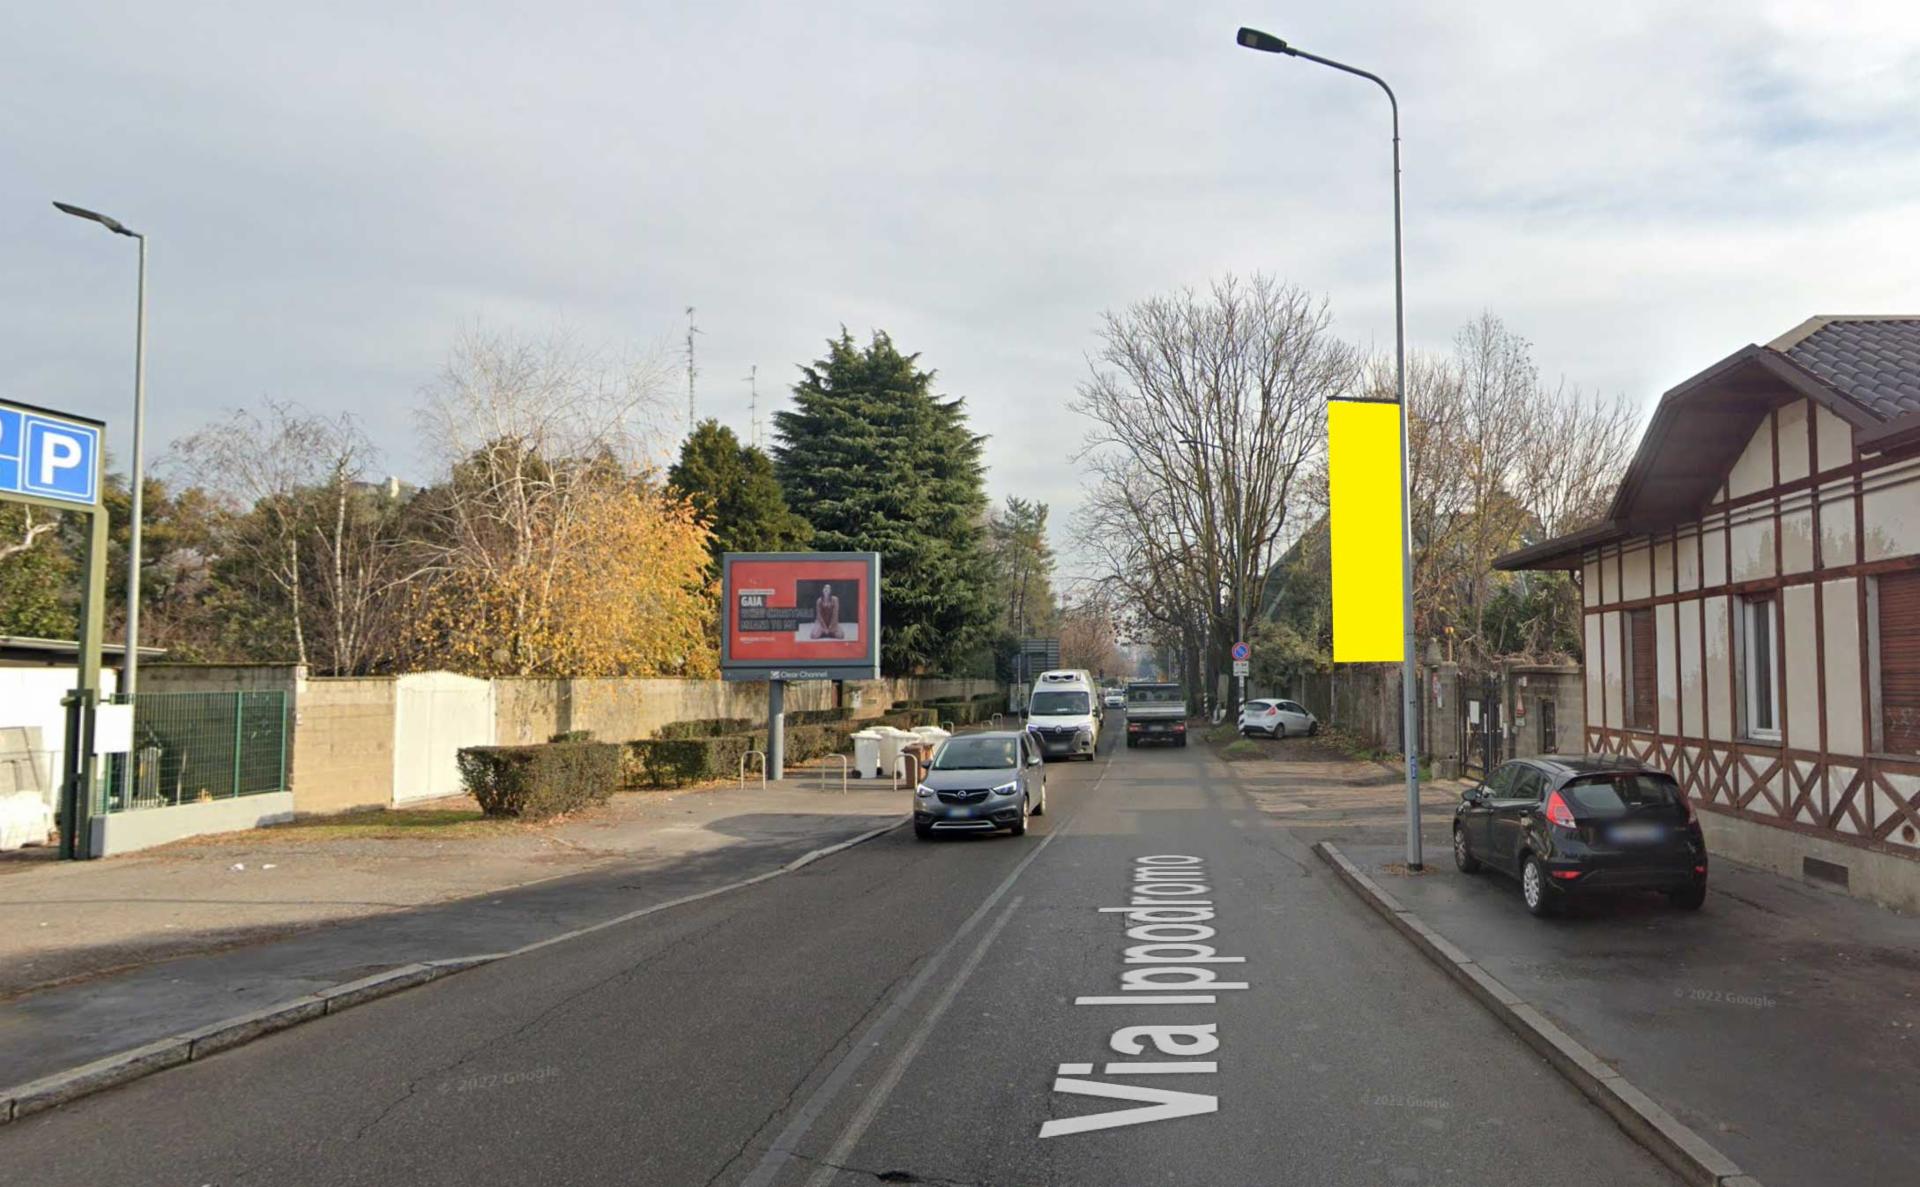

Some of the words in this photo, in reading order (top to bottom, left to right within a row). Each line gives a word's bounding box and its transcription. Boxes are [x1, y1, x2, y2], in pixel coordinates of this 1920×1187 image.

[40, 431, 82, 485] P
[741, 595, 763, 607] GAIA
[799, 670, 828, 678] Channel
